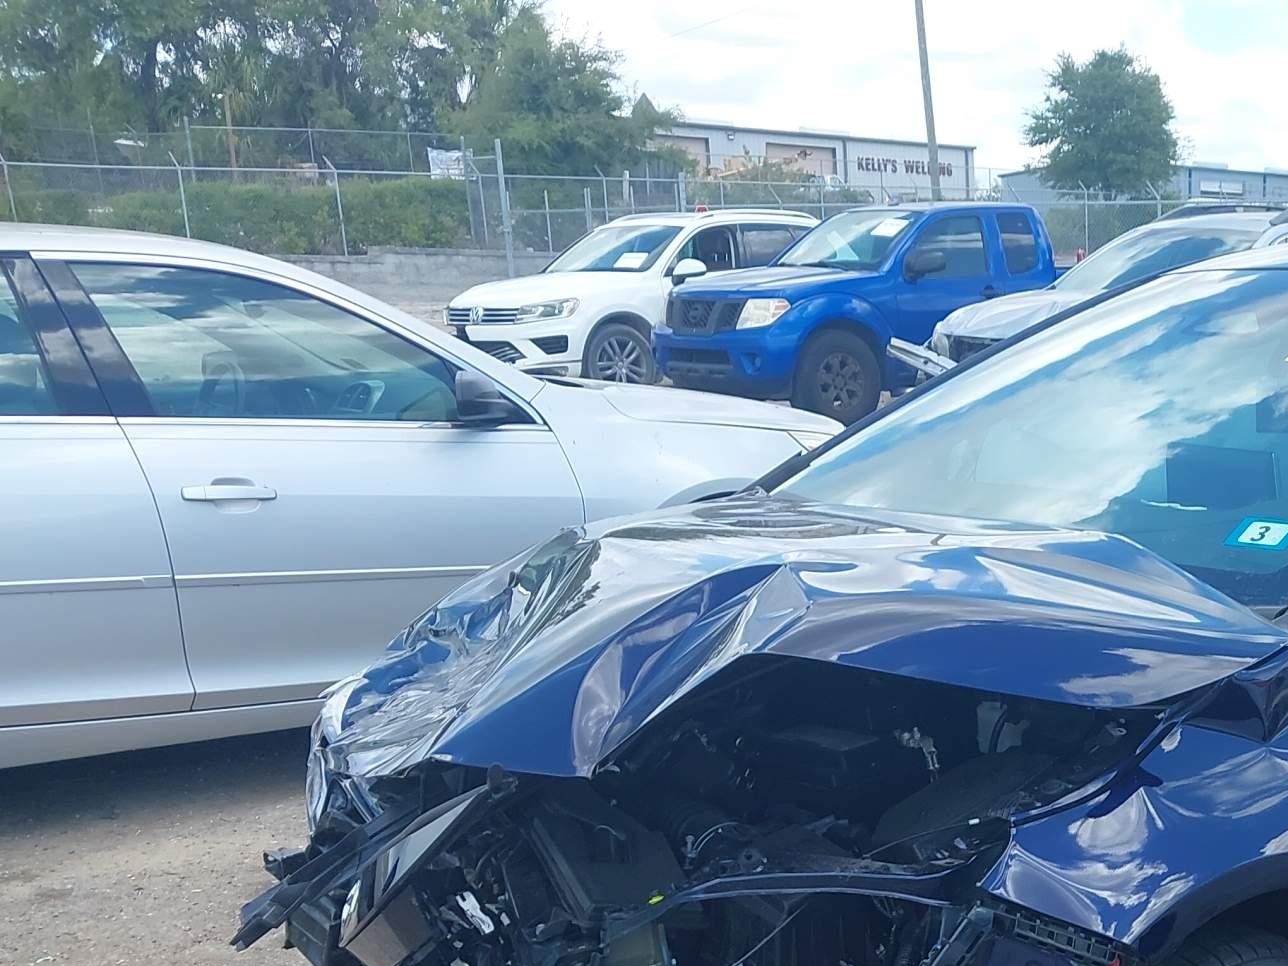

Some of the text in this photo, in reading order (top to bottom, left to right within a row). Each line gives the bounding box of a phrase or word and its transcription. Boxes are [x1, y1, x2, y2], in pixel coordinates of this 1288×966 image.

[857, 156, 953, 177] KELLY'S WELNG
[1250, 525, 1271, 542] 3
